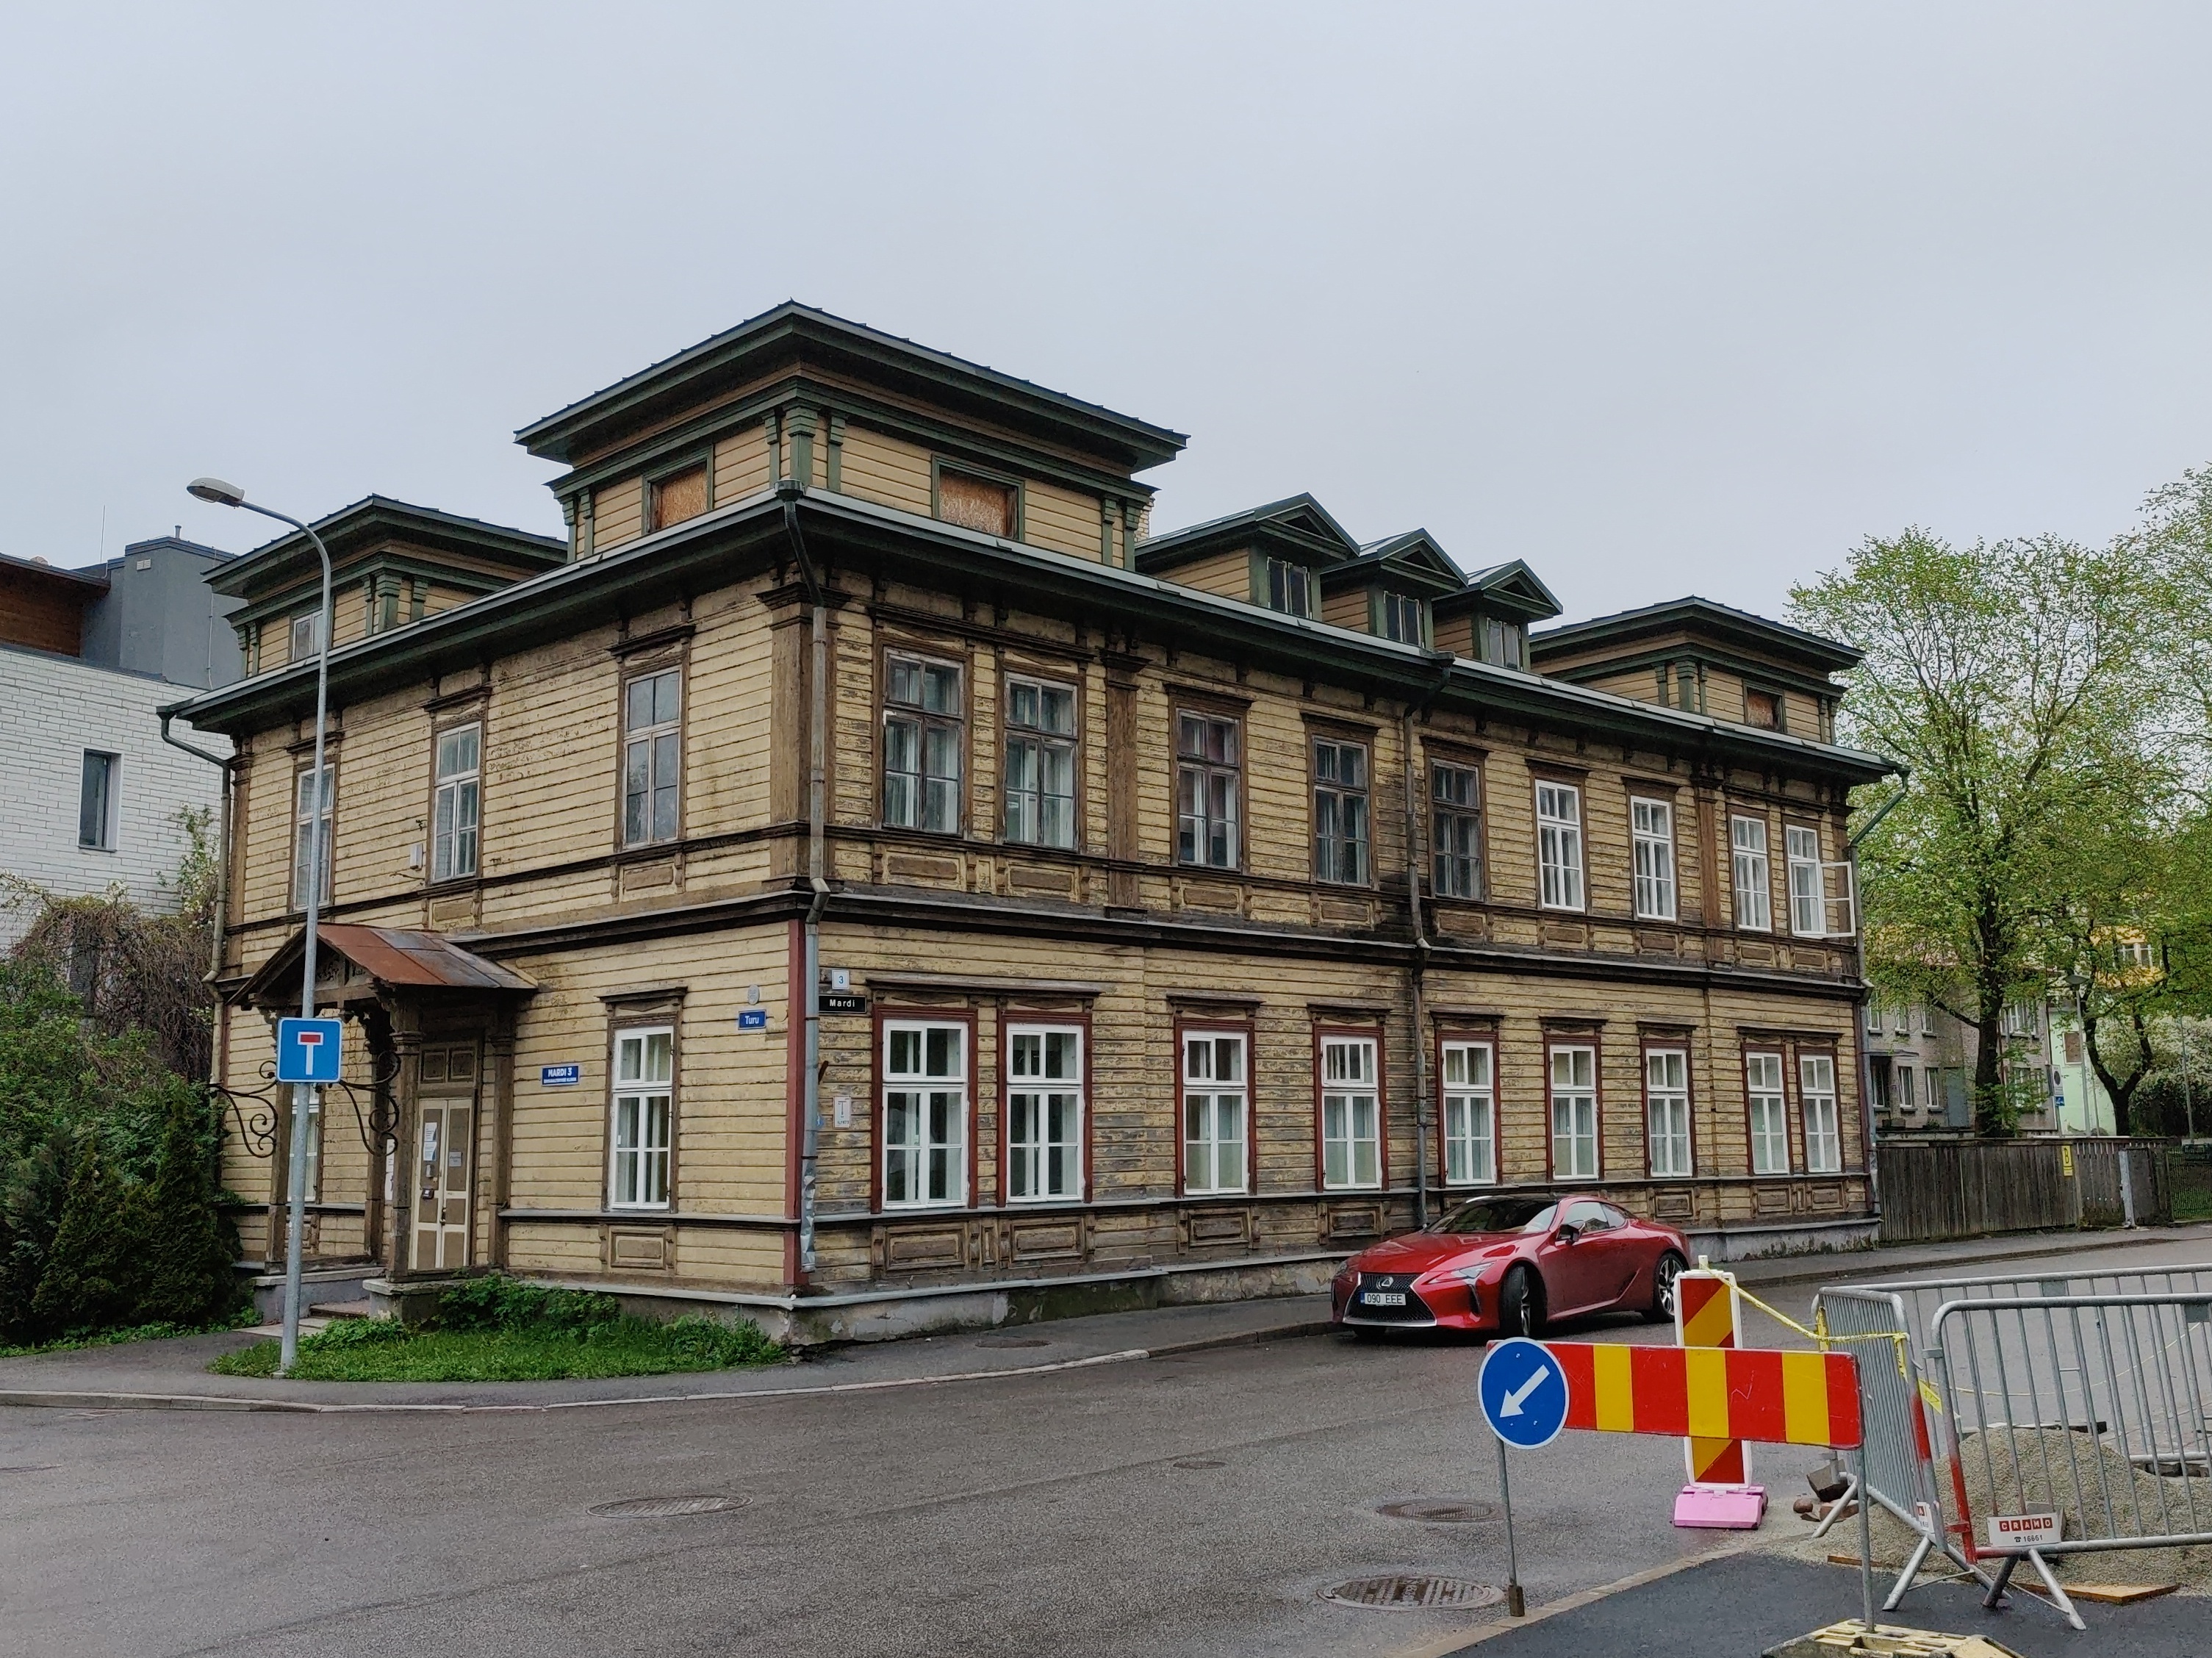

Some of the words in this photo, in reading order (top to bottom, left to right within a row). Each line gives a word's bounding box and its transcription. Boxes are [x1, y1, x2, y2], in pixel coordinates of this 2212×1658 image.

[839, 975, 844, 984] 3
[829, 999, 855, 1008] Mardi
[744, 1015, 760, 1024] Turu
[547, 1068, 567, 1077] MARDI
[567, 1067, 572, 1076] 3
[1367, 1293, 1381, 1304] 090
[1385, 1294, 1403, 1304] EEE
[2000, 1518, 2051, 1530] CRAMO
